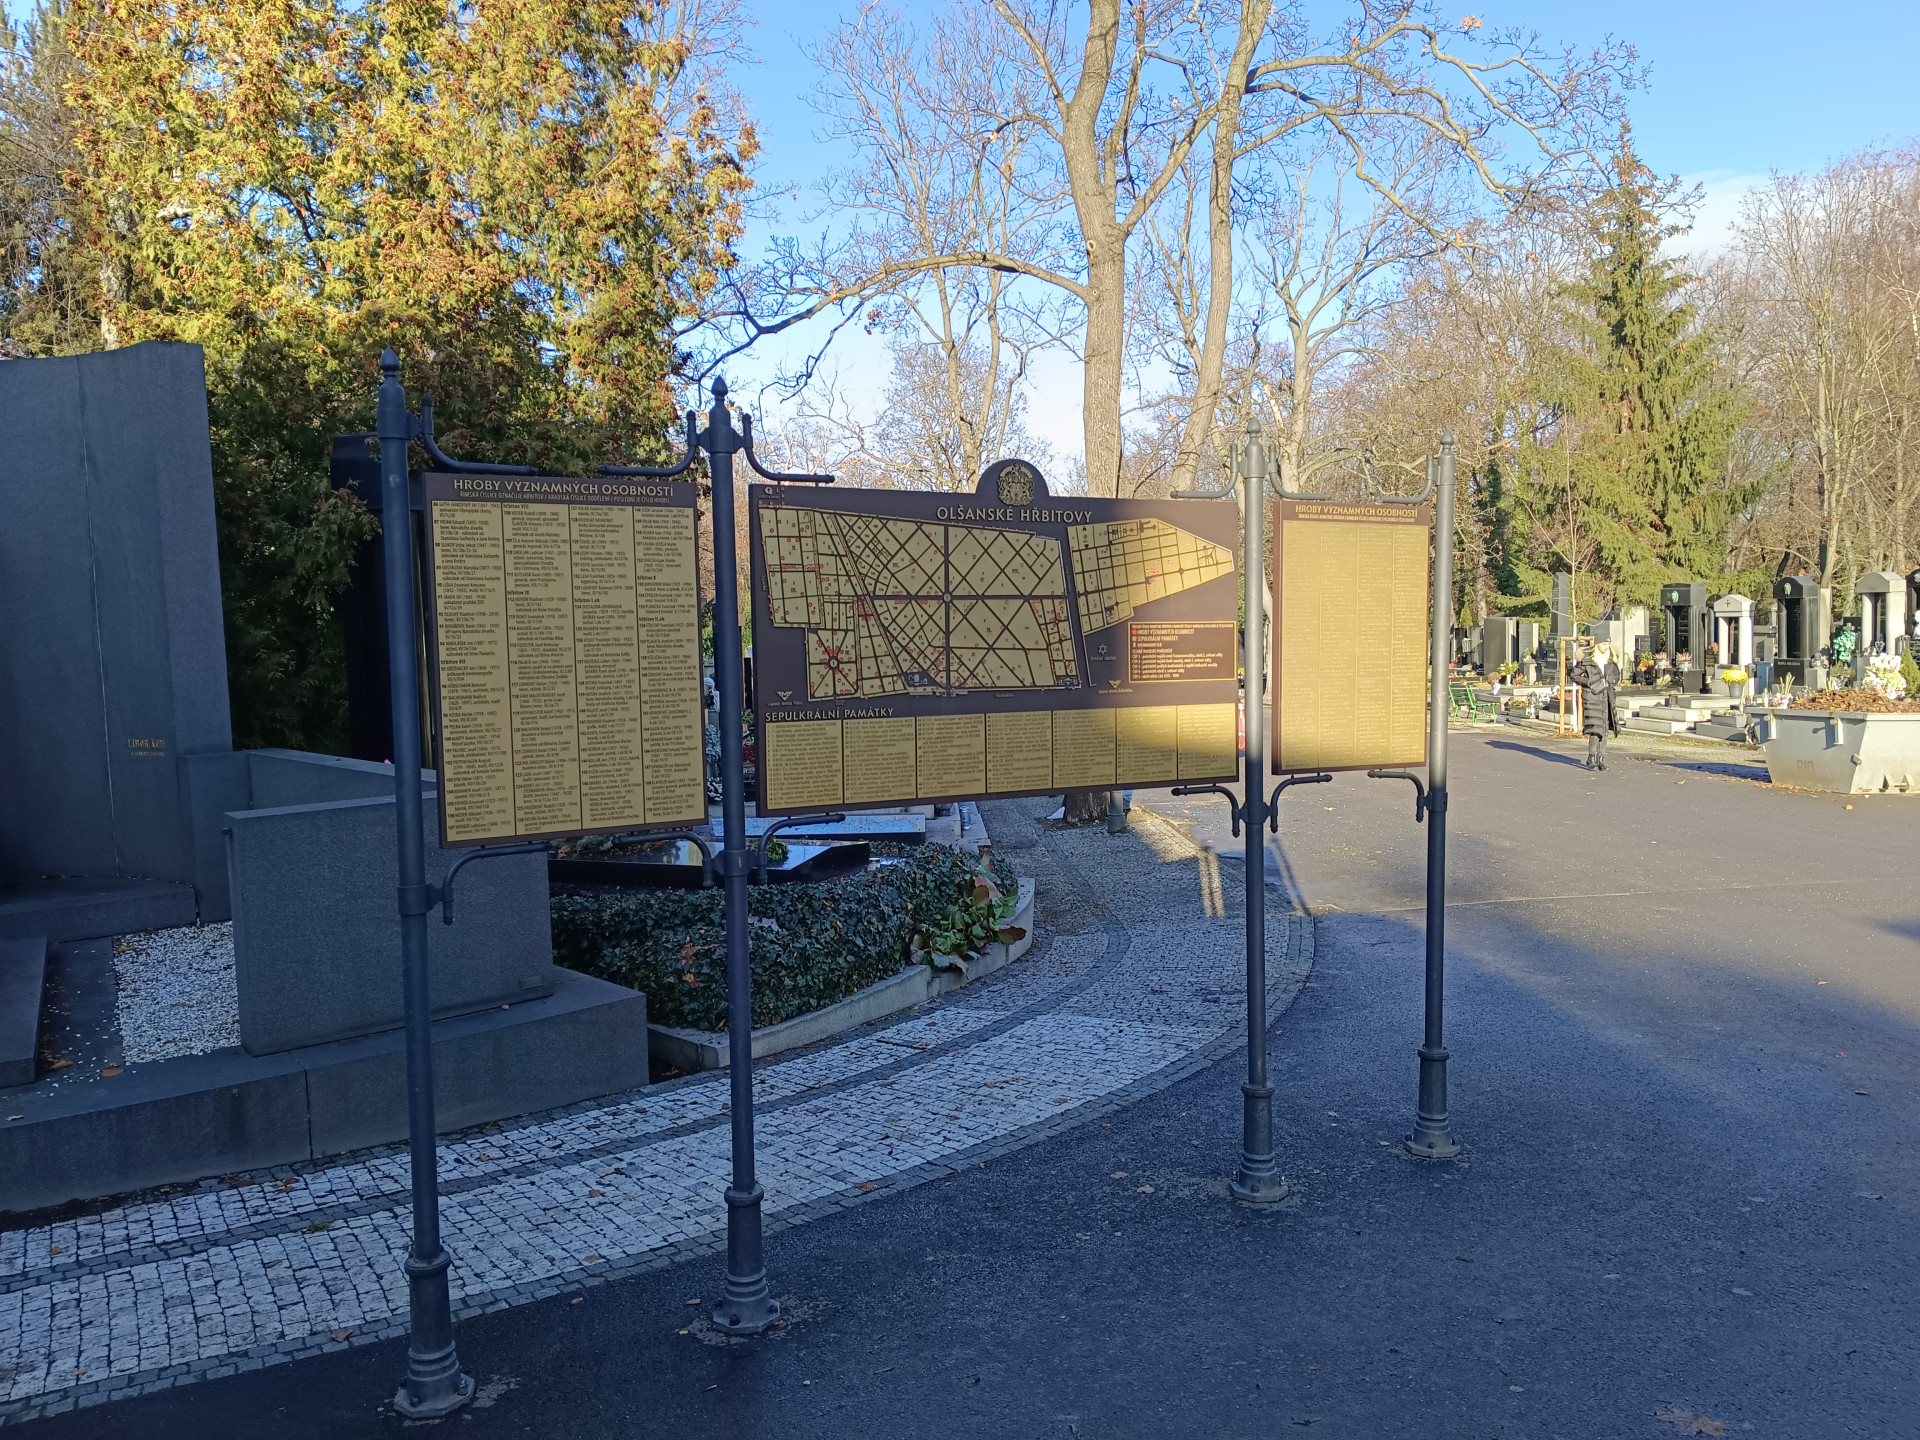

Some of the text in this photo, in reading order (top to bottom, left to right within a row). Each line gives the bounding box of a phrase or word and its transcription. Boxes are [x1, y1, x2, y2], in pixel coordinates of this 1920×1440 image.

[454, 478, 673, 496] HROBY VÝZNAMNÝCH OSOBNOSTÍ
[937, 504, 1092, 522] OLŠANSKÉ HŘBITOVY
[1296, 504, 1418, 517] HROBY VÝZNAMNÝCH OSOBNOSTÍ
[766, 706, 893, 721] SEPULKRÁLNÍ PAMÁTKY
